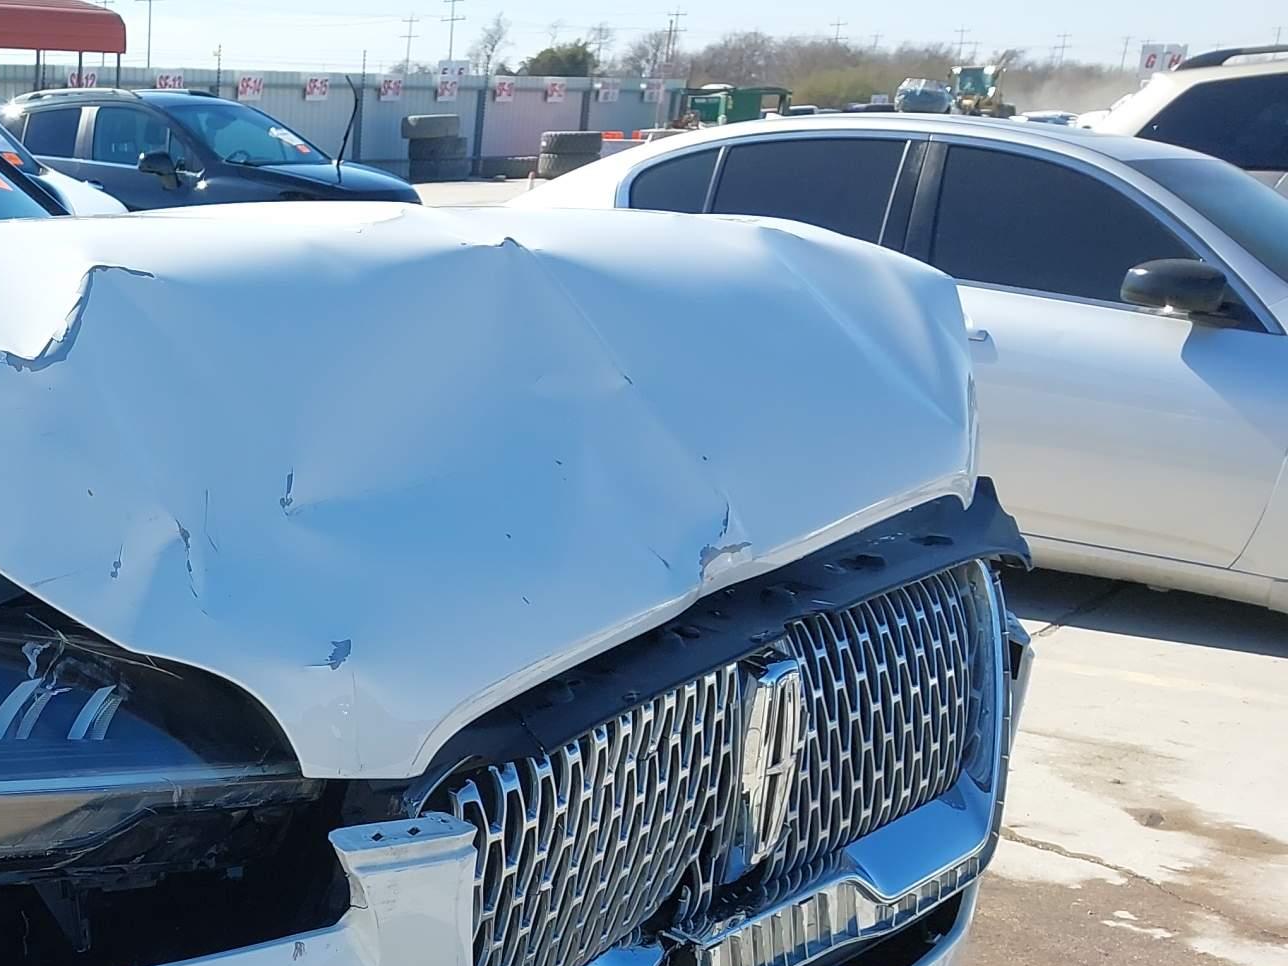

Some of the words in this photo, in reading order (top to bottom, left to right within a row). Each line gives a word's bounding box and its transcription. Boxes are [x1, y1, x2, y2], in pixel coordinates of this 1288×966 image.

[1145, 53, 1157, 69] G
[1168, 54, 1182, 69] H
[239, 77, 263, 96] SF-14
